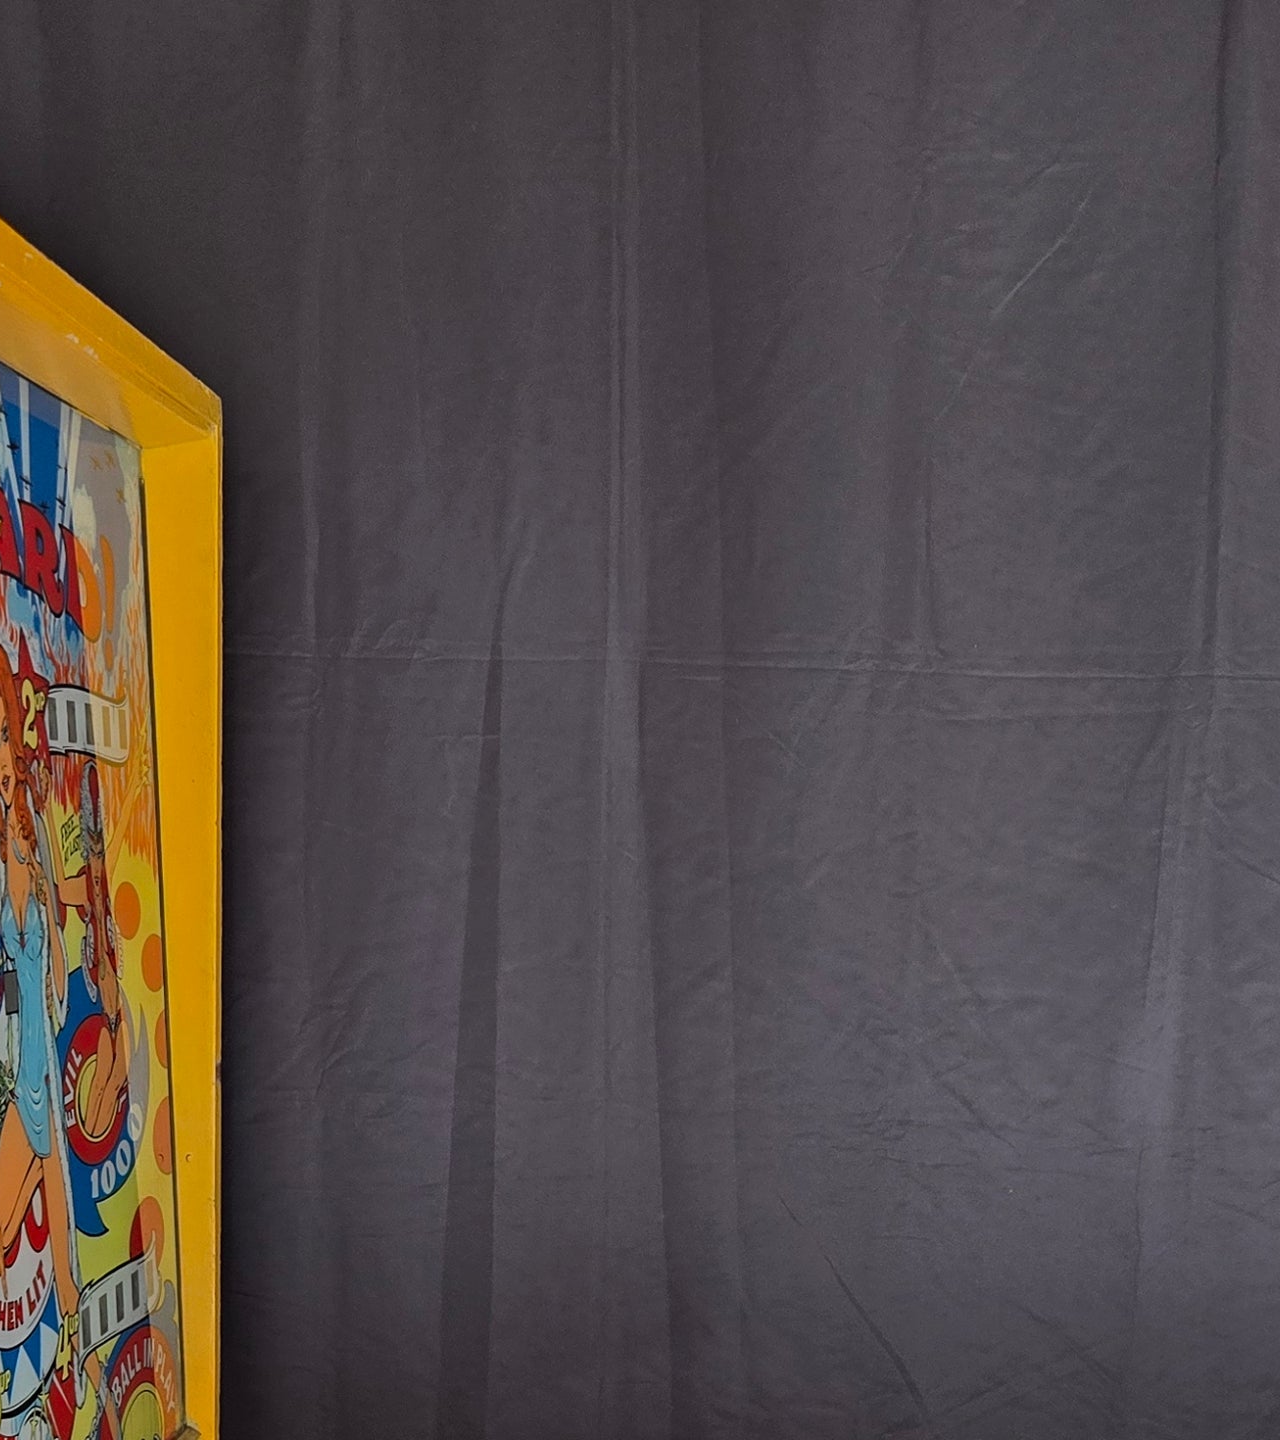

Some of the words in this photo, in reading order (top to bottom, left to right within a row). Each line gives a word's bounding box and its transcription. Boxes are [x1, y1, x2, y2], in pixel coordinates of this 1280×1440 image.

[64, 1048, 82, 1128] EVIL
[91, 1103, 143, 1198] 1000
[26, 1260, 47, 1317] LIT
[111, 1344, 141, 1408] BALL
[143, 1338, 155, 1368] IN
[156, 1344, 176, 1413] PLAY
